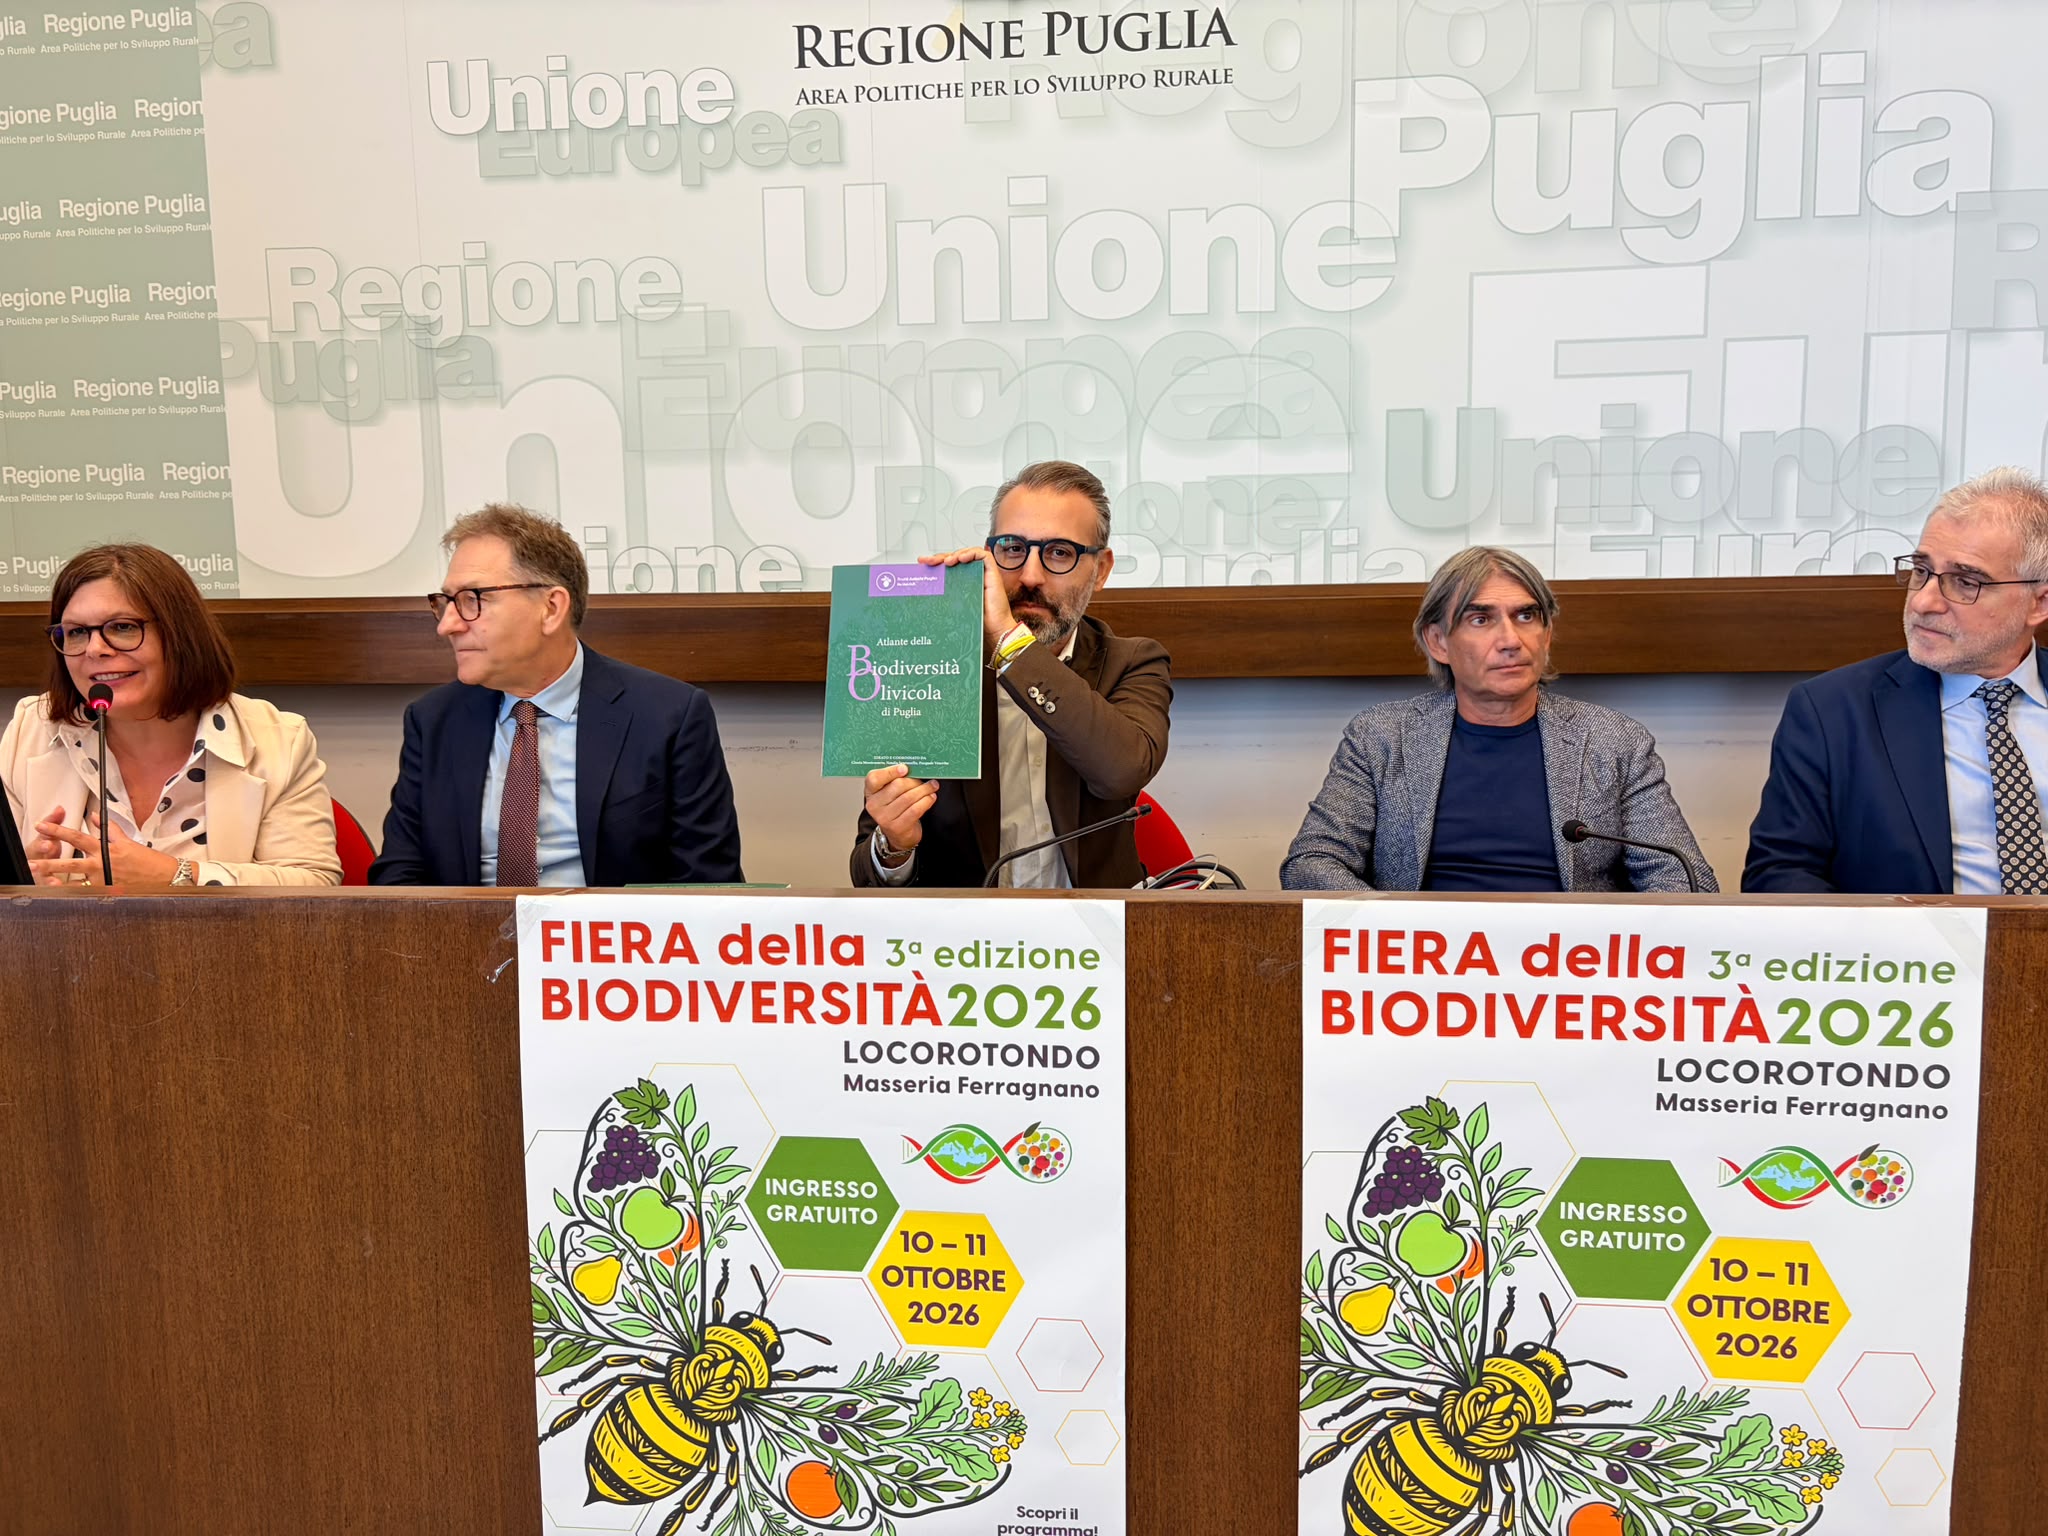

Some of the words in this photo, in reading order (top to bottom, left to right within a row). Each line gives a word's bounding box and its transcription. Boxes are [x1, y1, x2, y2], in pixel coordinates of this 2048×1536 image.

[44, 12, 126, 37] Regione
[130, 7, 193, 33] Puglia
[7, 45, 36, 55] Rurale
[40, 44, 61, 54] Area
[63, 42, 101, 53] Politiche
[103, 41, 118, 52] per
[120, 40, 129, 49] lo
[131, 38, 170, 50] Sviluppo
[427, 55, 734, 136] Unione
[56, 101, 117, 126] Puglia
[30, 135, 43, 144] per
[46, 133, 55, 142] lo
[57, 131, 95, 143] Sviluppo
[97, 129, 126, 139] Rurale
[131, 128, 151, 138] Area
[153, 126, 192, 137] Politiche
[1353, 50, 1995, 264] Puglia
[59, 198, 139, 222] Regione
[144, 193, 206, 218] Puglia
[23, 230, 51, 239] Rurale
[56, 228, 76, 237] Area
[78, 226, 115, 237] Politiche
[118, 226, 132, 236] per
[134, 225, 143, 234] lo
[145, 223, 184, 234] Sviluppo
[762, 174, 1398, 332] Unione
[70, 284, 131, 308] Puglia
[265, 242, 684, 350] Regione
[6, 316, 42, 326] Politiche
[45, 317, 59, 326] per
[61, 315, 69, 324] lo
[72, 314, 109, 325] Sviluppo
[111, 313, 140, 322] Rurale
[144, 312, 165, 321] Area
[167, 310, 205, 320] Politiche
[73, 378, 154, 402] Regione
[158, 376, 220, 400] Puglia
[38, 408, 66, 417] Rurale
[70, 407, 90, 416] Area
[92, 406, 130, 416] Politiche
[132, 407, 146, 416] per
[149, 406, 157, 414] lo
[159, 404, 198, 415] Sviluppo
[2, 465, 81, 489] Regione
[85, 462, 145, 486] Puglia
[1385, 403, 1941, 529] Unione
[21, 493, 58, 503] Politiche
[60, 493, 73, 503] per
[75, 493, 84, 501] lo
[86, 491, 124, 502] Sviluppo
[126, 491, 154, 500] Rurale
[159, 490, 179, 499] Area
[181, 489, 219, 499] Politiche
[877, 637, 908, 647] Atlante
[911, 637, 932, 647] della
[846, 644, 960, 677] Biodiversità
[848, 667, 942, 702] Olivicola
[881, 707, 891, 717] di
[893, 708, 921, 719] Puglia
[541, 920, 699, 966] FIERA
[718, 923, 865, 967] della
[934, 939, 1100, 971] edizione
[1323, 928, 1499, 977] FIERA
[1521, 932, 1686, 979] della
[1763, 951, 1956, 985] edizione
[541, 970, 942, 1028] BIODIVERSITÀ
[947, 984, 1101, 1031] 2026
[1321, 983, 1771, 1044] BIODIVERSITÀ
[1777, 998, 1954, 1048] 2026
[843, 1040, 1100, 1070] LOCOROTONDO
[1657, 1057, 1951, 1090] LOCOROTONDO
[843, 1074, 950, 1095] Masseria
[958, 1075, 1100, 1100] Ferragnano
[1655, 1092, 1778, 1115] Masseria
[1786, 1094, 1950, 1121] Ferragnano
[765, 1178, 878, 1199] INGRESSO
[766, 1205, 878, 1225] GRATUITO
[1559, 1201, 1688, 1224] INGRESSO
[900, 1230, 933, 1253] 10
[965, 1233, 986, 1256] 11
[1559, 1229, 1686, 1252] GRATUITO
[881, 1265, 1006, 1292] OTTOBRE
[1710, 1257, 1748, 1282] 10
[1785, 1261, 1809, 1286] 11
[908, 1301, 980, 1326] 2026
[1687, 1294, 1830, 1325] OTTOBRE
[1715, 1332, 1797, 1359] 2026
[1016, 1505, 1067, 1522] Scopri
[1070, 1508, 1078, 1520] il
